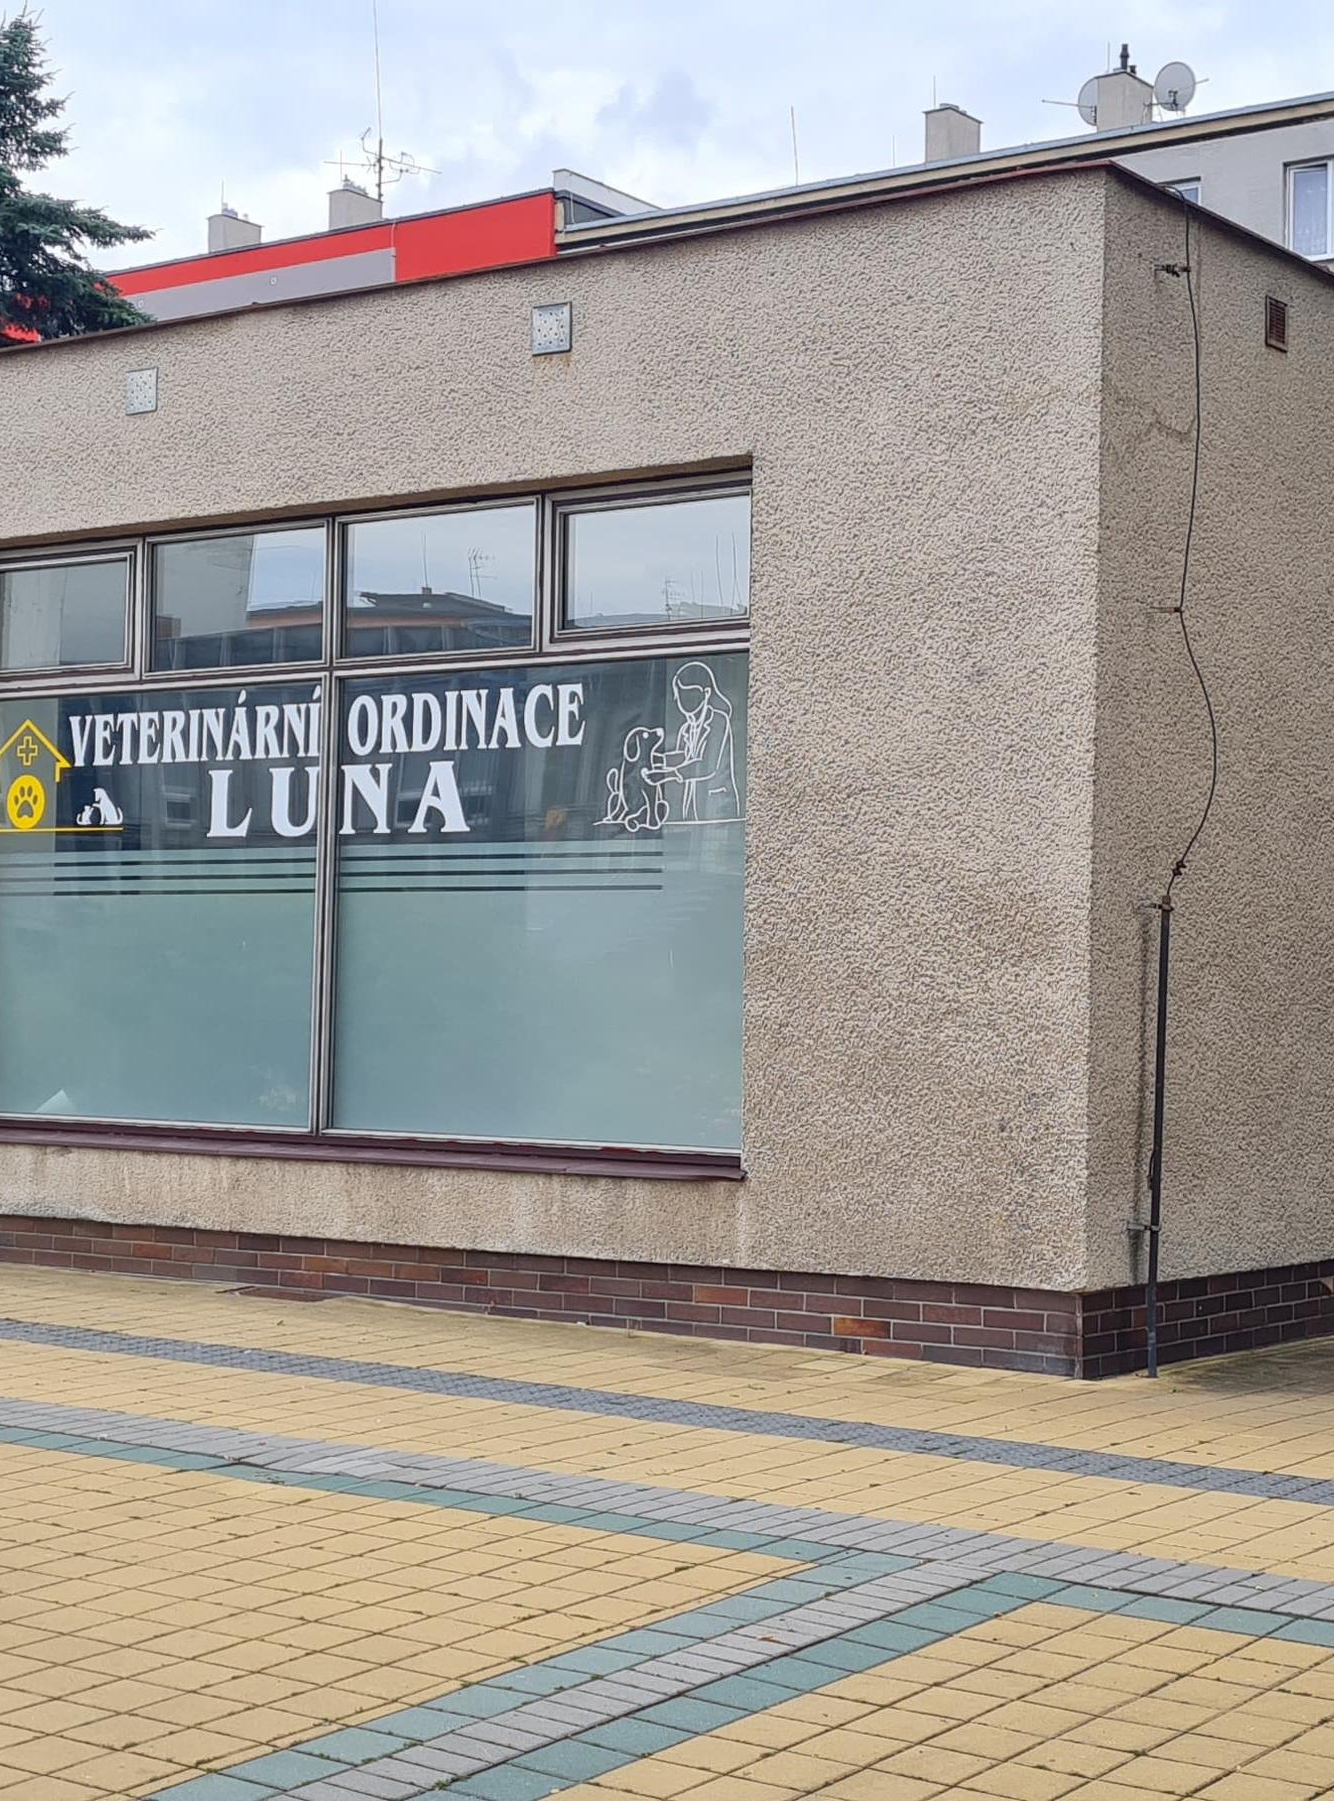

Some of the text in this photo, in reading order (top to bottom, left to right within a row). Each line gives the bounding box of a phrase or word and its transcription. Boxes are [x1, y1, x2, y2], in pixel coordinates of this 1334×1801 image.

[69, 683, 586, 767] VETERINÁRNÍ ORDINACE
[206, 761, 470, 838] LUNA
